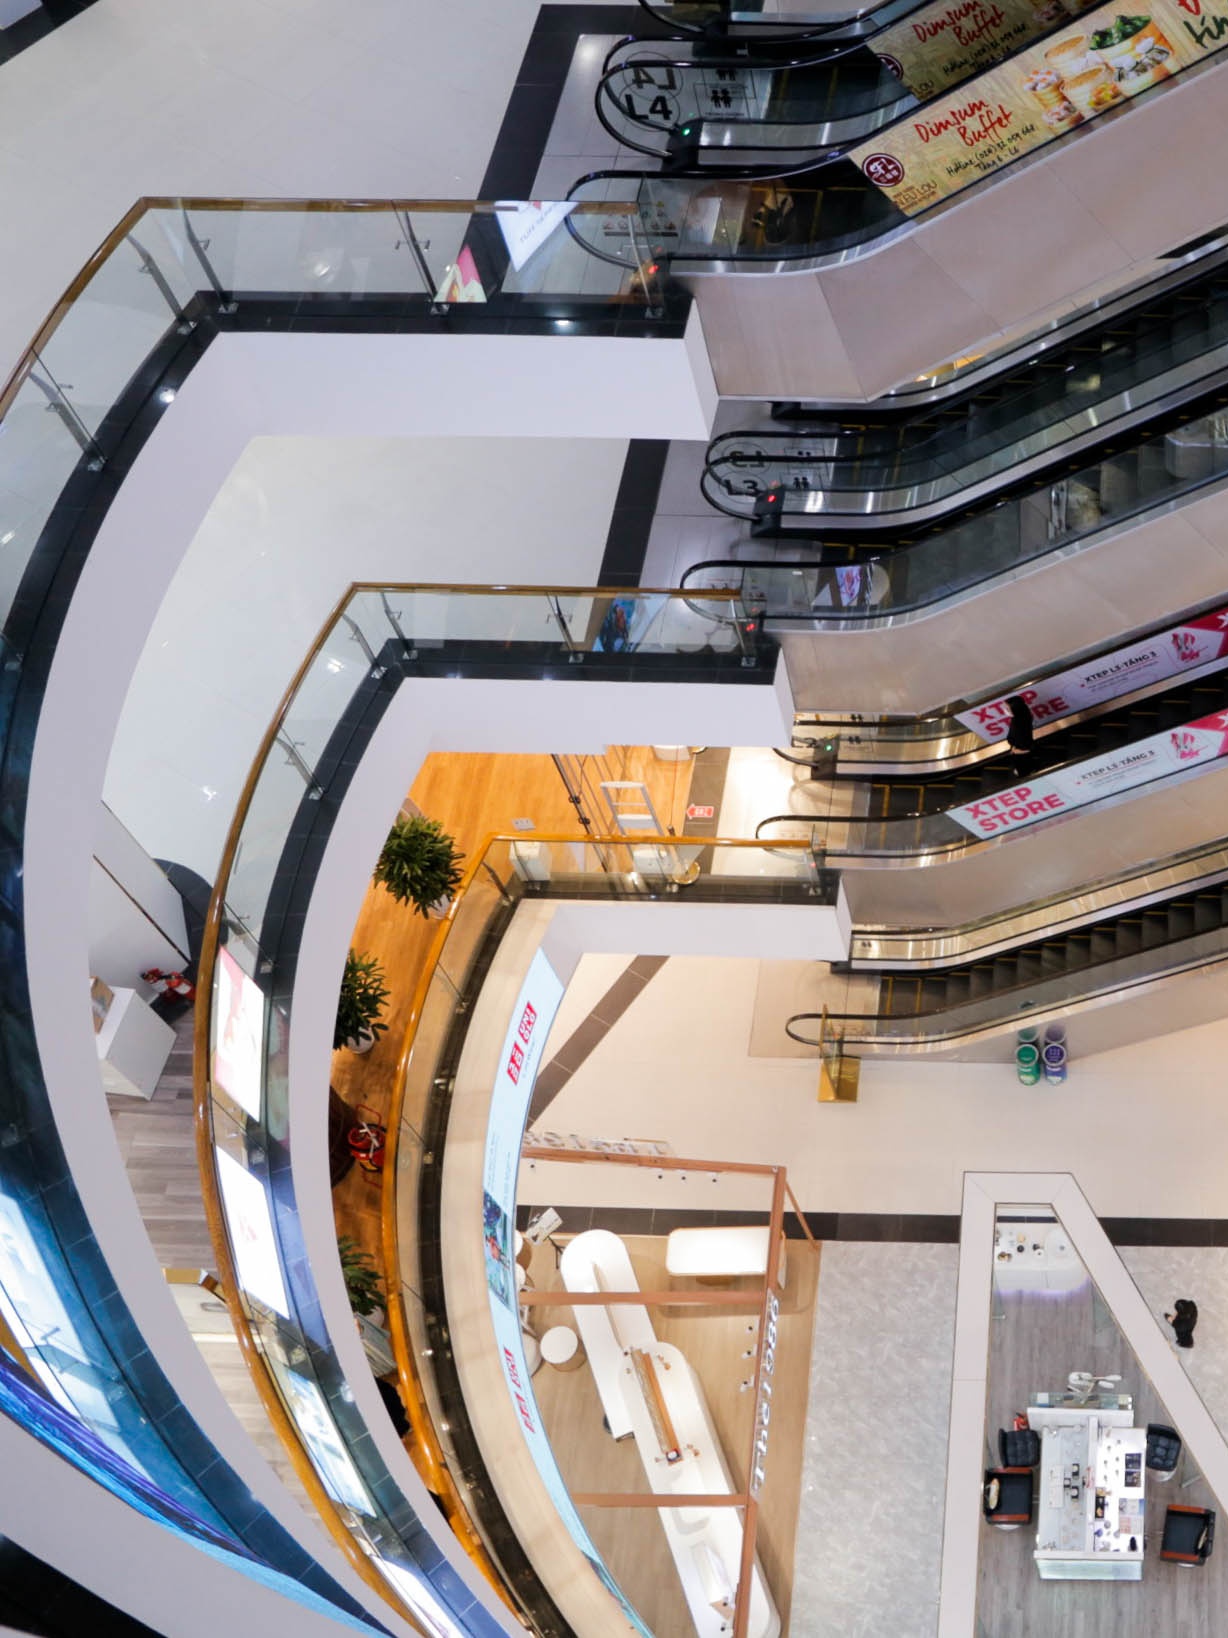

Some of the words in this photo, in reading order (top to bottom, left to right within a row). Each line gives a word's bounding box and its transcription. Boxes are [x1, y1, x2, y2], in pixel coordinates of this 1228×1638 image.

[912, 0, 983, 43] Dimsum
[953, 4, 1005, 46] Buffet
[624, 93, 673, 121] L4
[914, 100, 989, 143] Dimsum
[957, 104, 1012, 147] Buffet
[723, 479, 760, 496] L3
[1085, 670, 1108, 682] XTEP
[972, 690, 1038, 723] XTP
[985, 696, 1070, 736] STRE
[965, 787, 1032, 820] XTEP
[978, 793, 1065, 832] STORE
